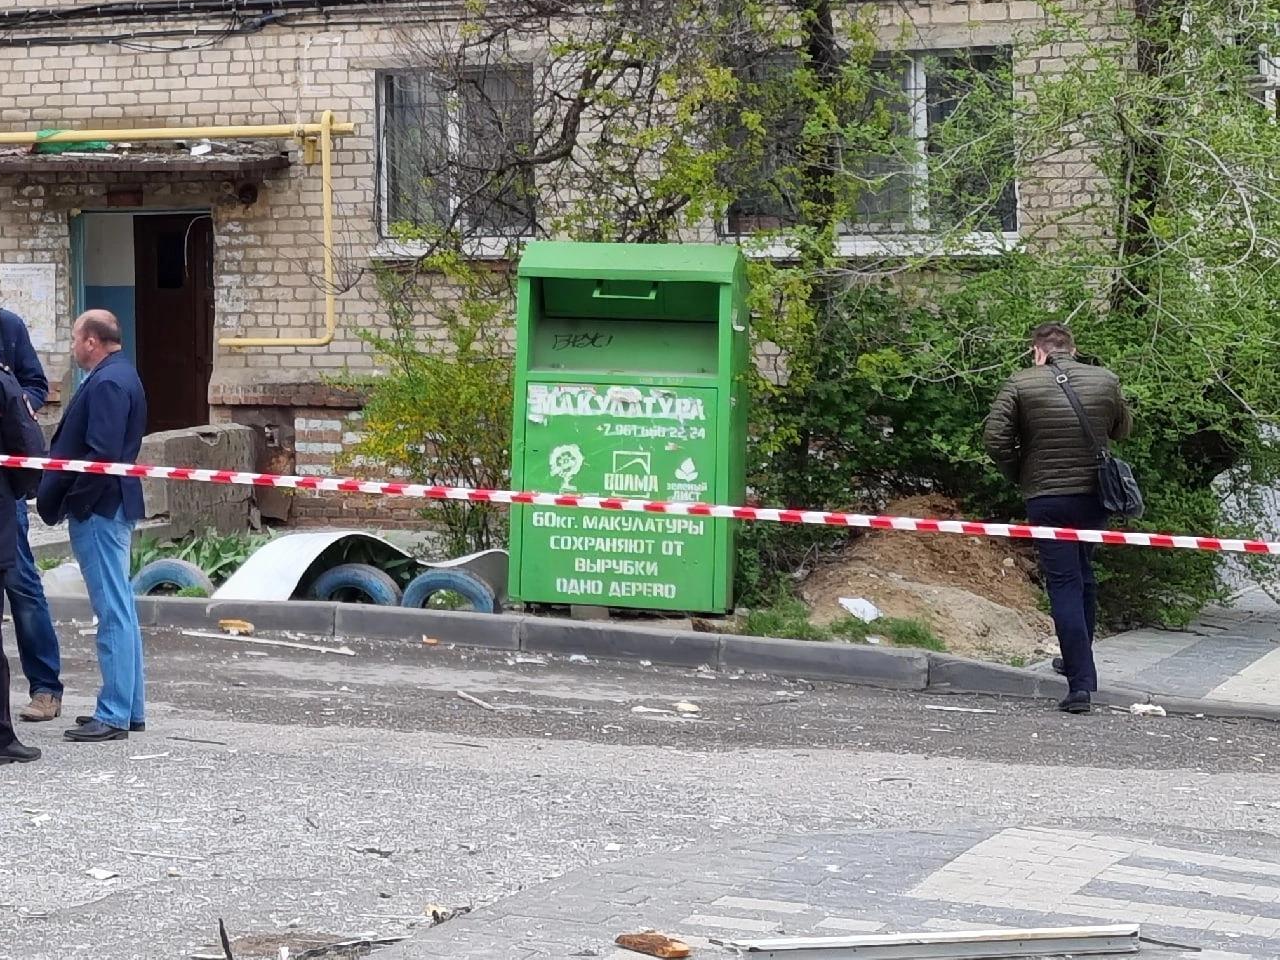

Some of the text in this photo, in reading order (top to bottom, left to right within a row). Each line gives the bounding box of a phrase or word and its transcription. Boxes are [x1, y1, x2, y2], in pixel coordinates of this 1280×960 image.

[582, 515, 704, 536] МАКУЛАТУРЫ
[549, 535, 685, 557] СОХРАНЯЮТ ОТ
[574, 557, 659, 577] ВЫРУБКИ
[556, 577, 603, 596] ОДНО
